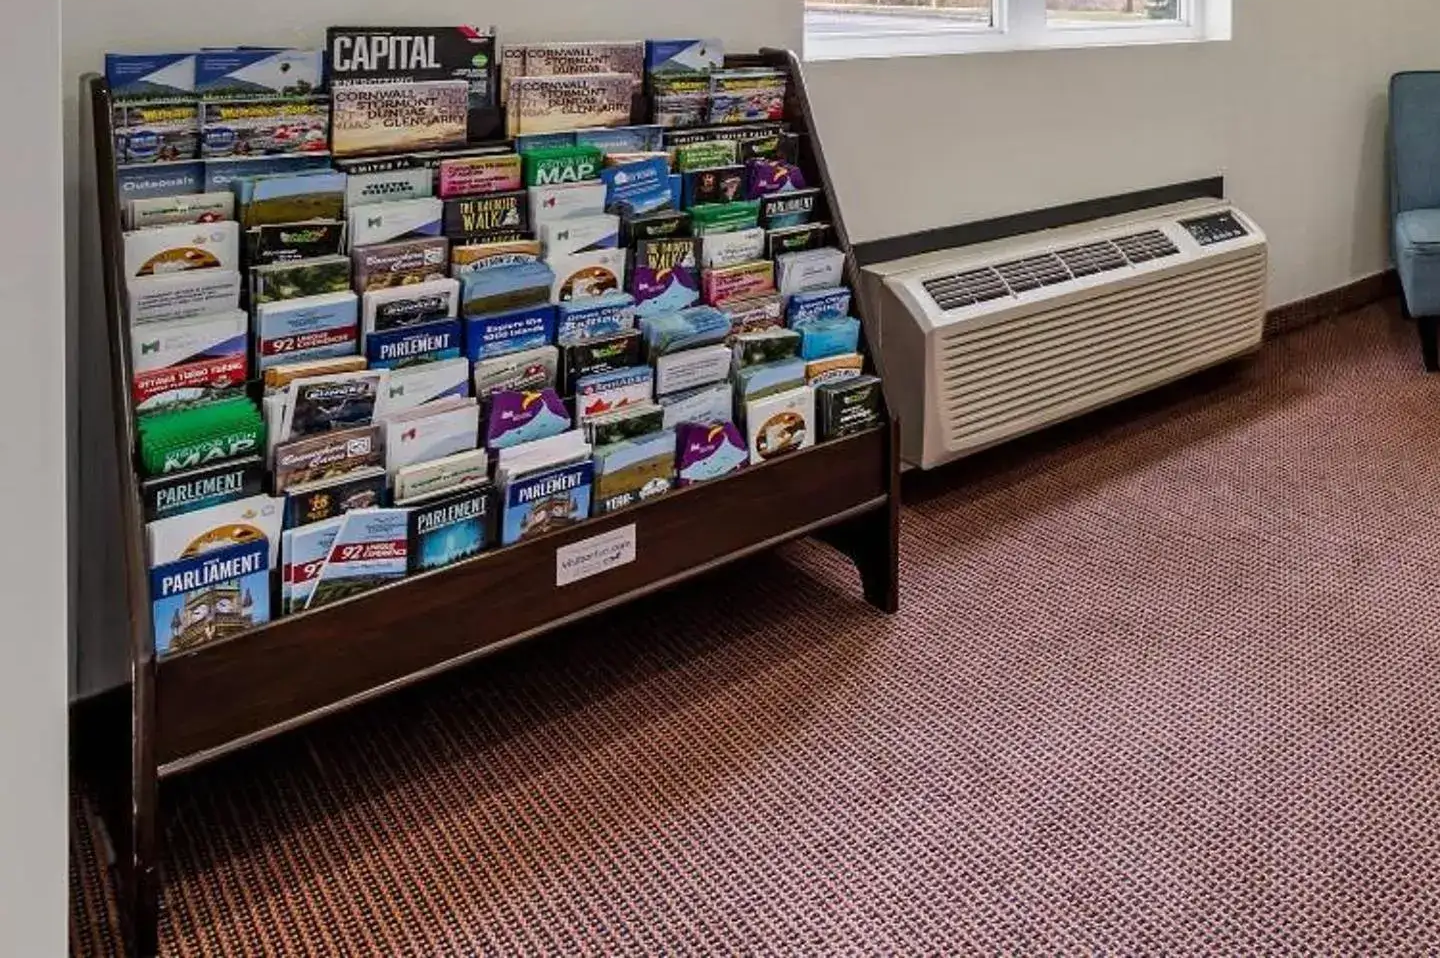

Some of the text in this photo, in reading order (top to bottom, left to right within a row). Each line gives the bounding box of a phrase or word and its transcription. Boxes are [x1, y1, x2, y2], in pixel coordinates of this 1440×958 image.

[333, 35, 442, 72] CAPITAL
[528, 49, 594, 59] CORNWALL
[544, 56, 610, 66] STORMONT
[522, 80, 589, 91] CORNWALL
[541, 88, 608, 98] STORMONT
[335, 89, 418, 102] CORNWALL
[548, 97, 598, 107] DUNDAS
[356, 98, 438, 111] STORMONT
[367, 107, 427, 120] DUNDAS
[383, 114, 465, 128] GLENGARRY
[536, 164, 595, 185] MAP
[463, 211, 499, 232] WALK
[483, 325, 545, 341] 1000 Islands
[486, 318, 543, 334] Explore the
[273, 339, 295, 352] 92
[380, 334, 451, 359] PARLEMENT
[163, 439, 255, 472] MAP
[156, 471, 245, 508] PARLEMENT
[518, 472, 583, 503] PARLEMENT
[417, 496, 488, 529] PARLEMENT
[342, 545, 365, 559] 92
[162, 552, 262, 596] PARLIAMENT
